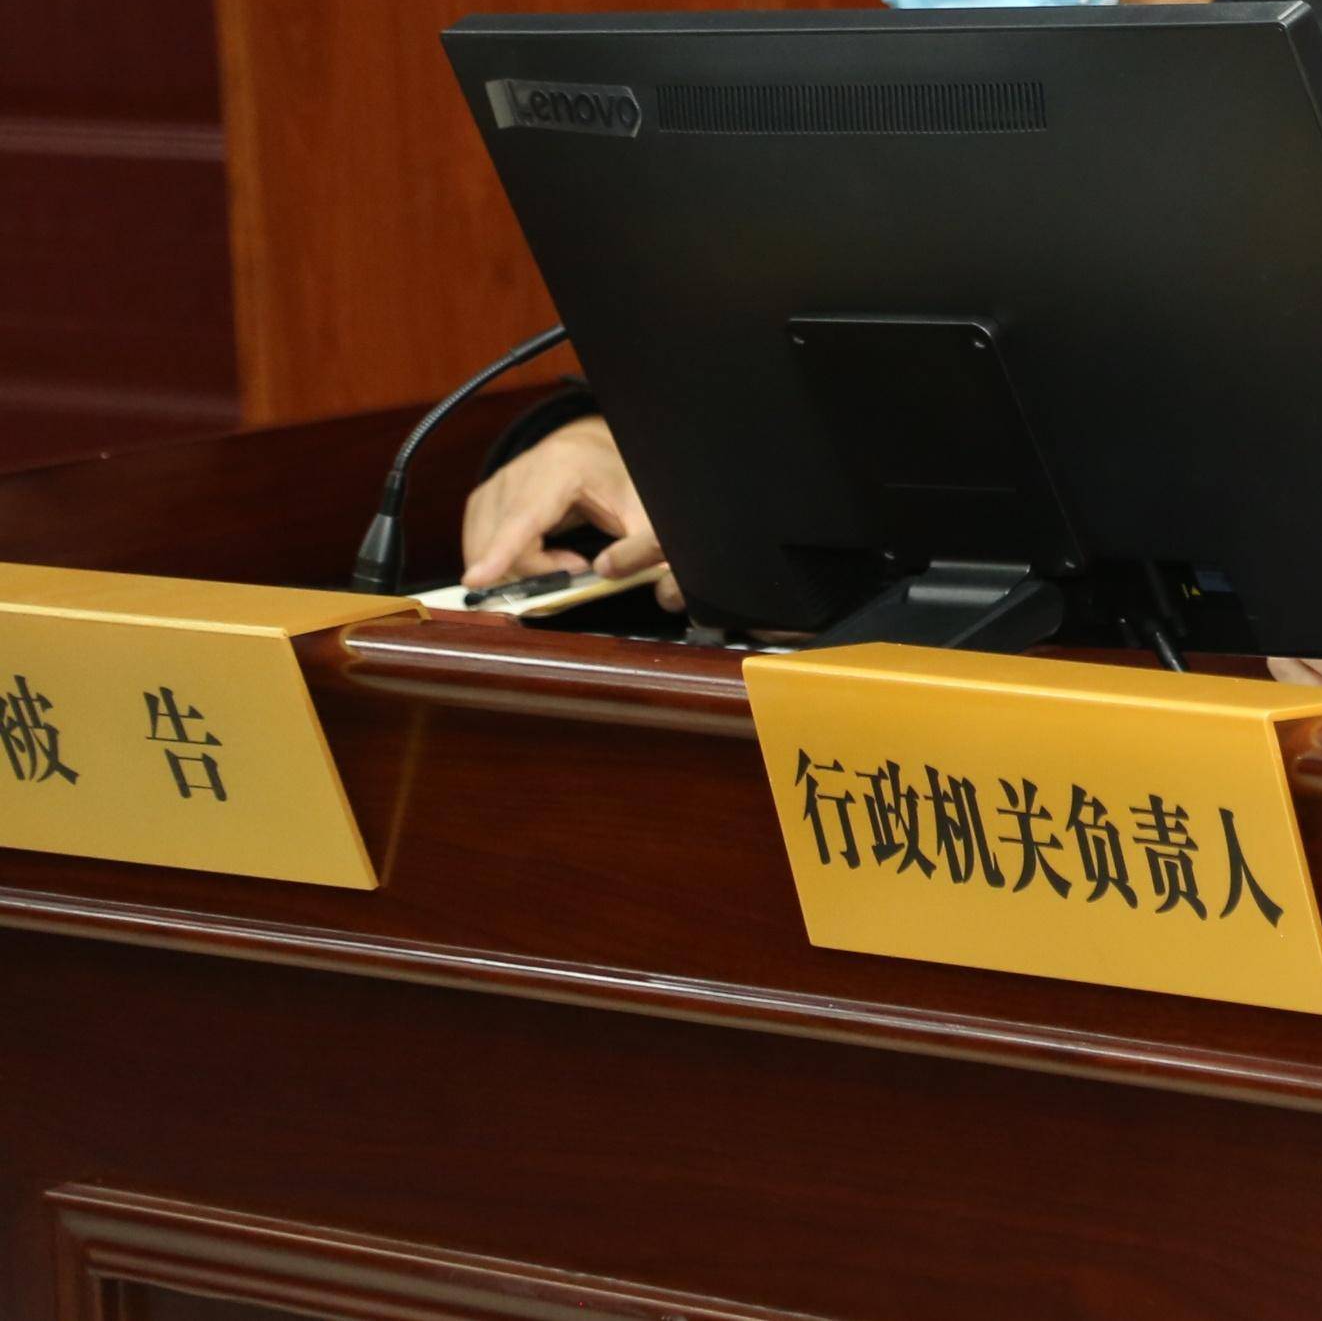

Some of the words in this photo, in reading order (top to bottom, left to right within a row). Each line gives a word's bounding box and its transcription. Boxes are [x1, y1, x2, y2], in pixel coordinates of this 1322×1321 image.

[507, 80, 640, 128] Lenovo
[794, 748, 1285, 928] 行政机关负责人
